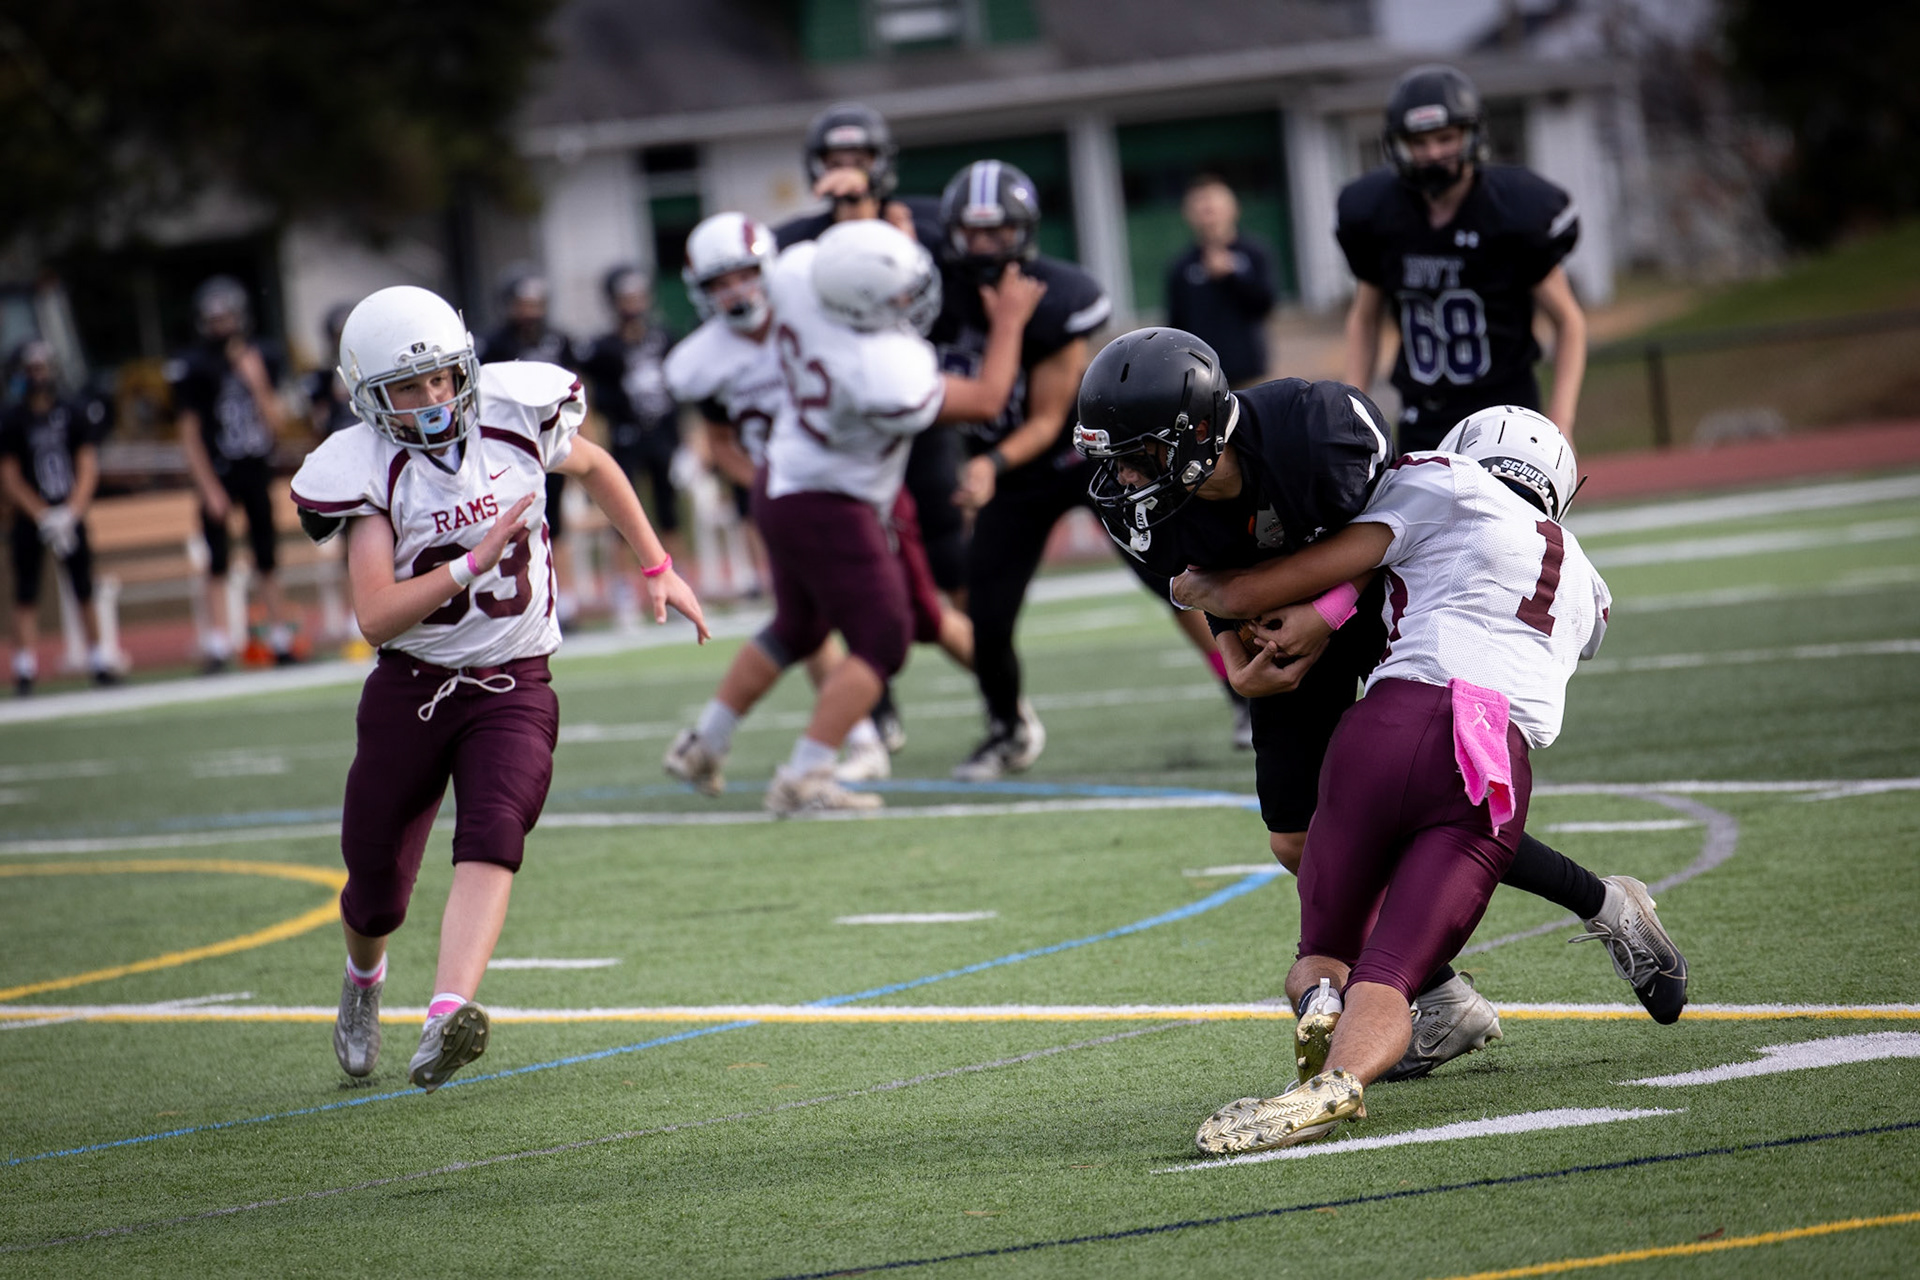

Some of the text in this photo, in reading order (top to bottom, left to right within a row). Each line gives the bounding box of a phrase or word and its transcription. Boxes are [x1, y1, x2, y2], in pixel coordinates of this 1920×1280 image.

[1398, 289, 1491, 384] 68
[1500, 459, 1549, 486] schutt
[431, 494, 499, 534] RAMS
[1515, 519, 1564, 637] 1
